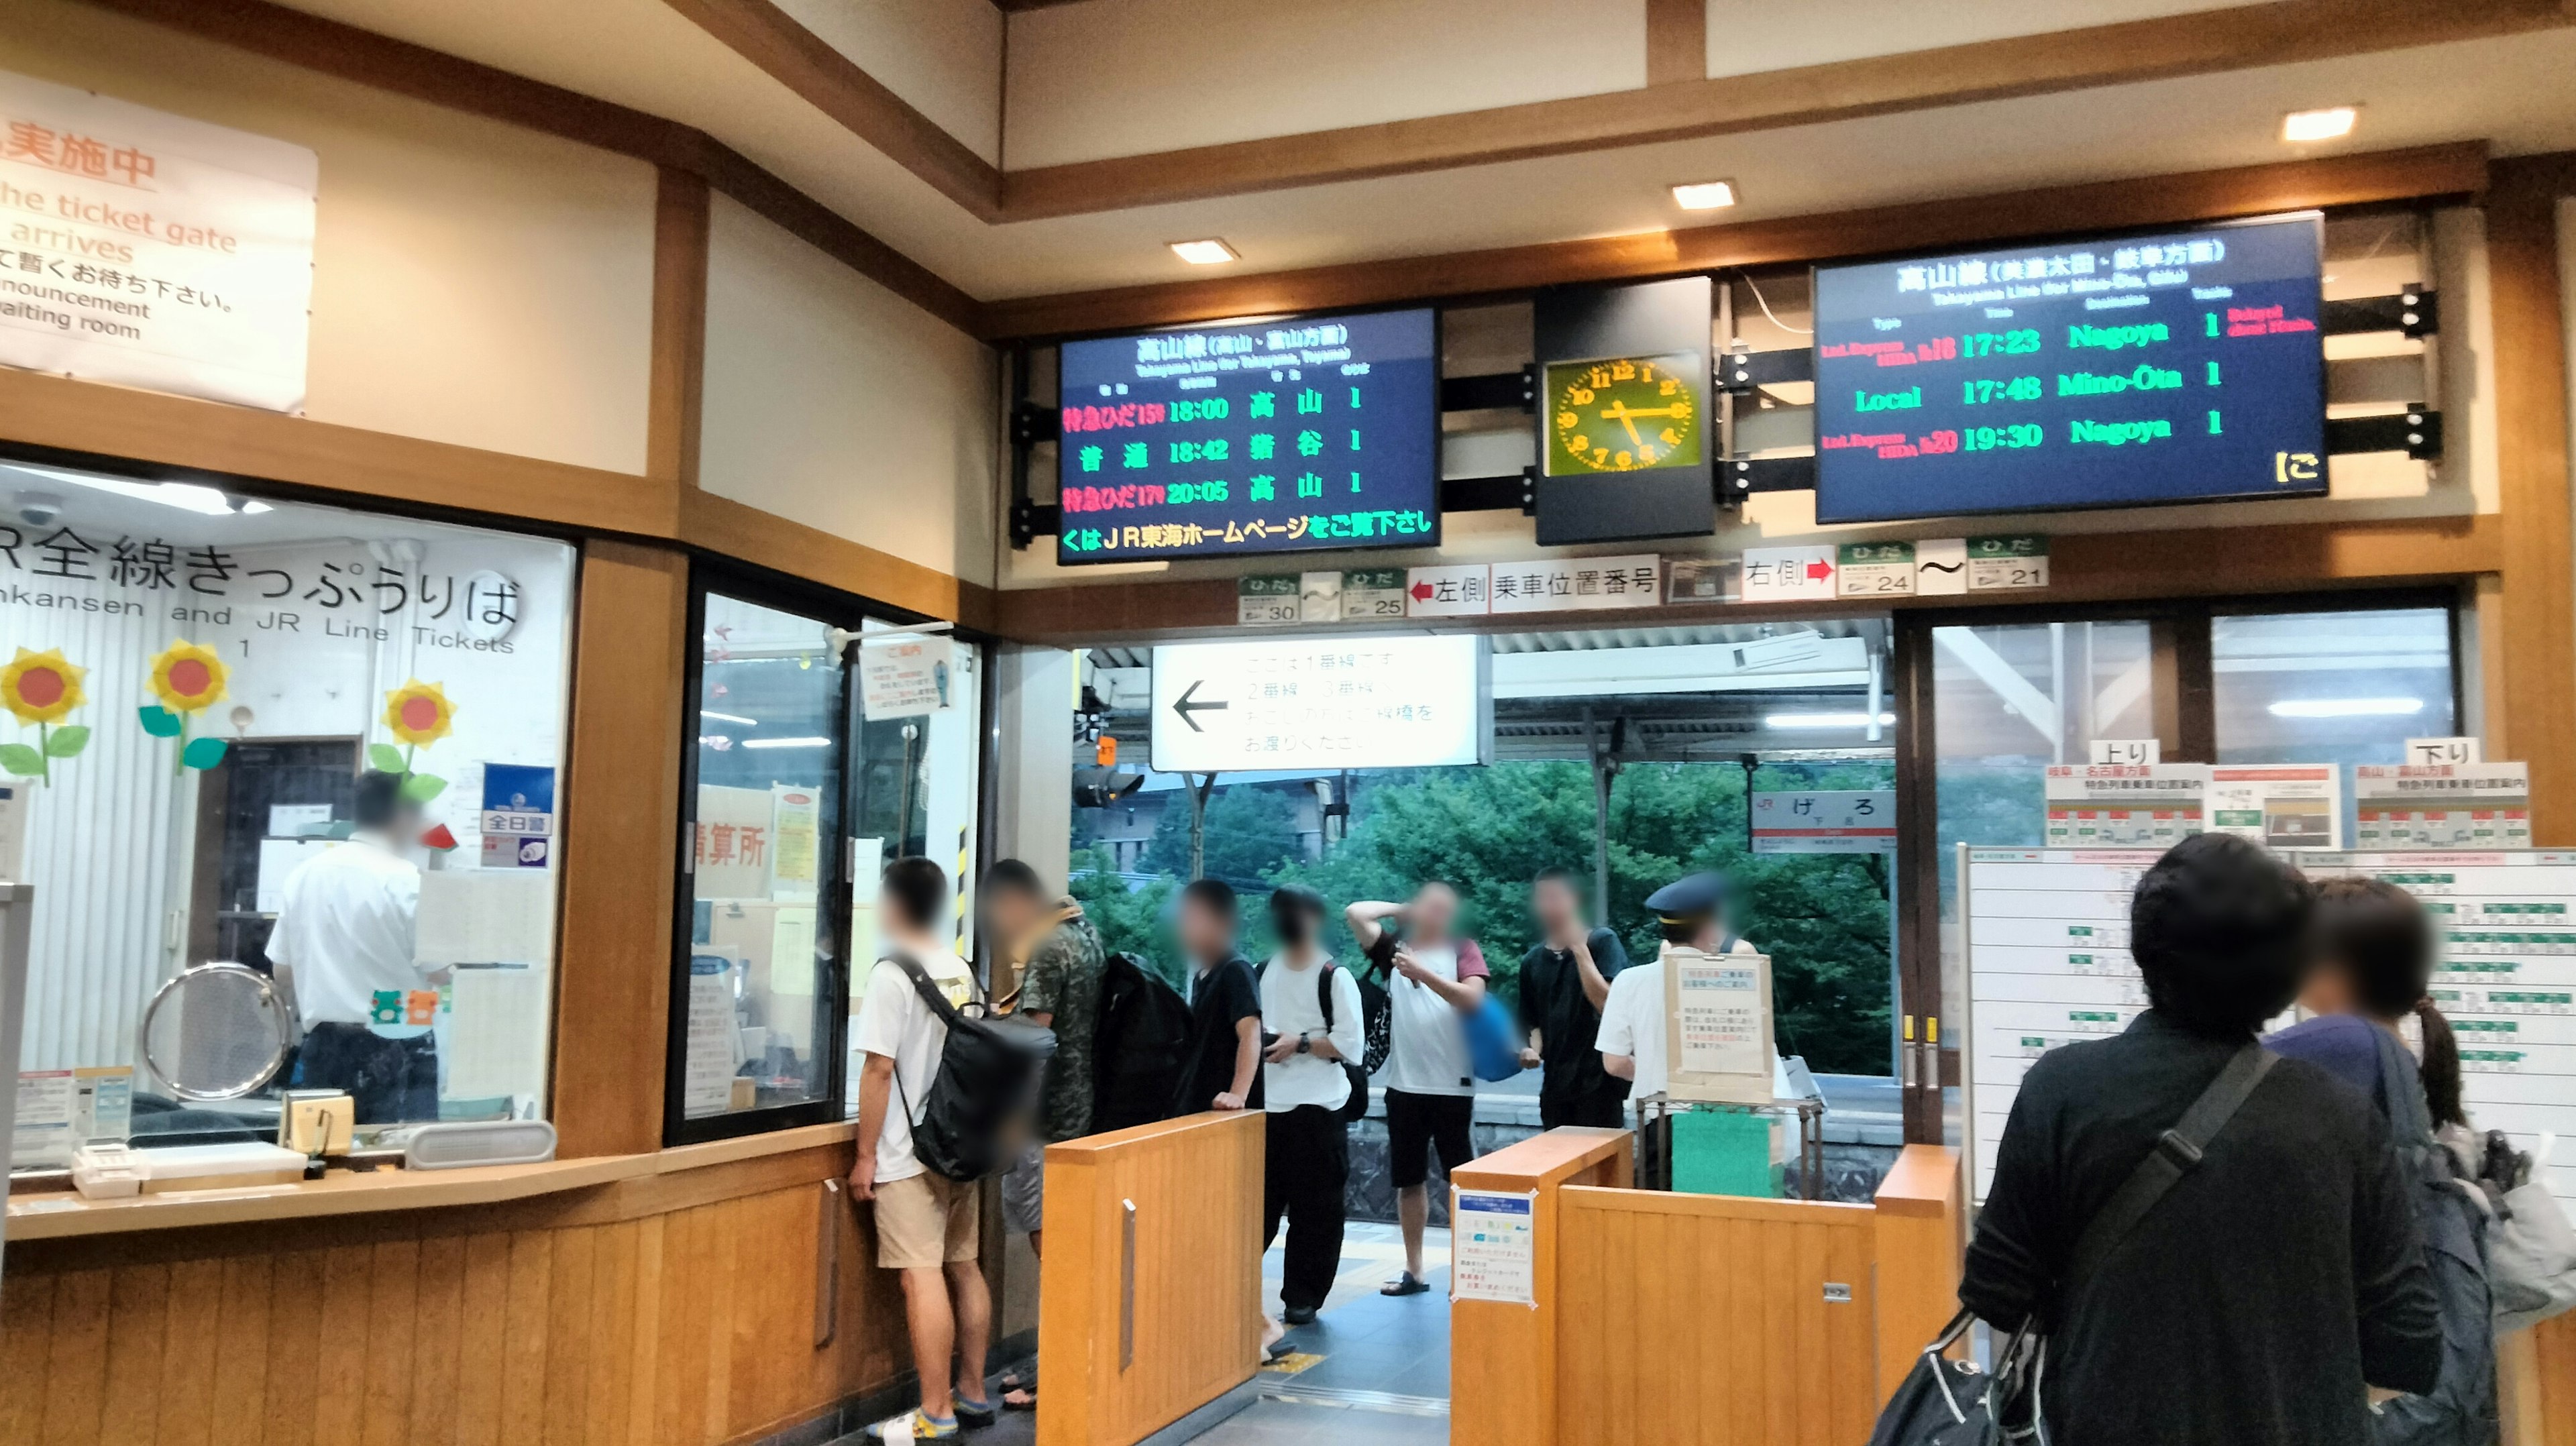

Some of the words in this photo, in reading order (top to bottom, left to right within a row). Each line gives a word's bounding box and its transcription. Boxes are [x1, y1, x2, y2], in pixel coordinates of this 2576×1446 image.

[0, 121, 155, 184] 実施中
[58, 194, 155, 236] ticket
[166, 223, 237, 254] gate
[11, 222, 134, 264] arrives
[0, 278, 151, 320] nouncement
[79, 316, 141, 340] room
[2069, 323, 2170, 351] Nagoya
[2205, 312, 2220, 337] 1
[1963, 328, 2041, 358] 17:23
[1613, 364, 1635, 381] 12
[2206, 361, 2222, 386] 1
[1350, 386, 1362, 408] 1
[1573, 389, 1595, 406] 10
[1659, 380, 1677, 396] 2
[1855, 386, 1922, 412] Local
[1963, 376, 2043, 404] 17:48
[1170, 397, 1229, 423] 18:00
[2208, 410, 2223, 435] 1
[1350, 429, 1362, 451] 1
[1660, 428, 1678, 445] 4
[1964, 423, 2043, 451] 19:30
[2070, 420, 2172, 445] Nagoya
[1170, 439, 1229, 463] 18:42
[1593, 447, 1609, 465] 7
[1615, 451, 1633, 467] 6
[1167, 480, 1229, 505] 20:05
[1350, 471, 1362, 493] 1
[1494, 567, 1658, 600] 乗車位置番号
[1746, 560, 1805, 588] 右側
[1878, 575, 1909, 592] 24
[2012, 569, 2041, 585] 21
[1434, 577, 1487, 603] 左側
[1269, 606, 1295, 620] 30
[1375, 600, 1401, 614] 25
[171, 607, 231, 625] and
[256, 611, 301, 632] JR
[325, 616, 390, 642] Line
[411, 625, 515, 655] Tickets
[2098, 743, 2147, 765] 上り
[2415, 742, 2469, 765] 下り
[1793, 797, 1874, 816] げろ
